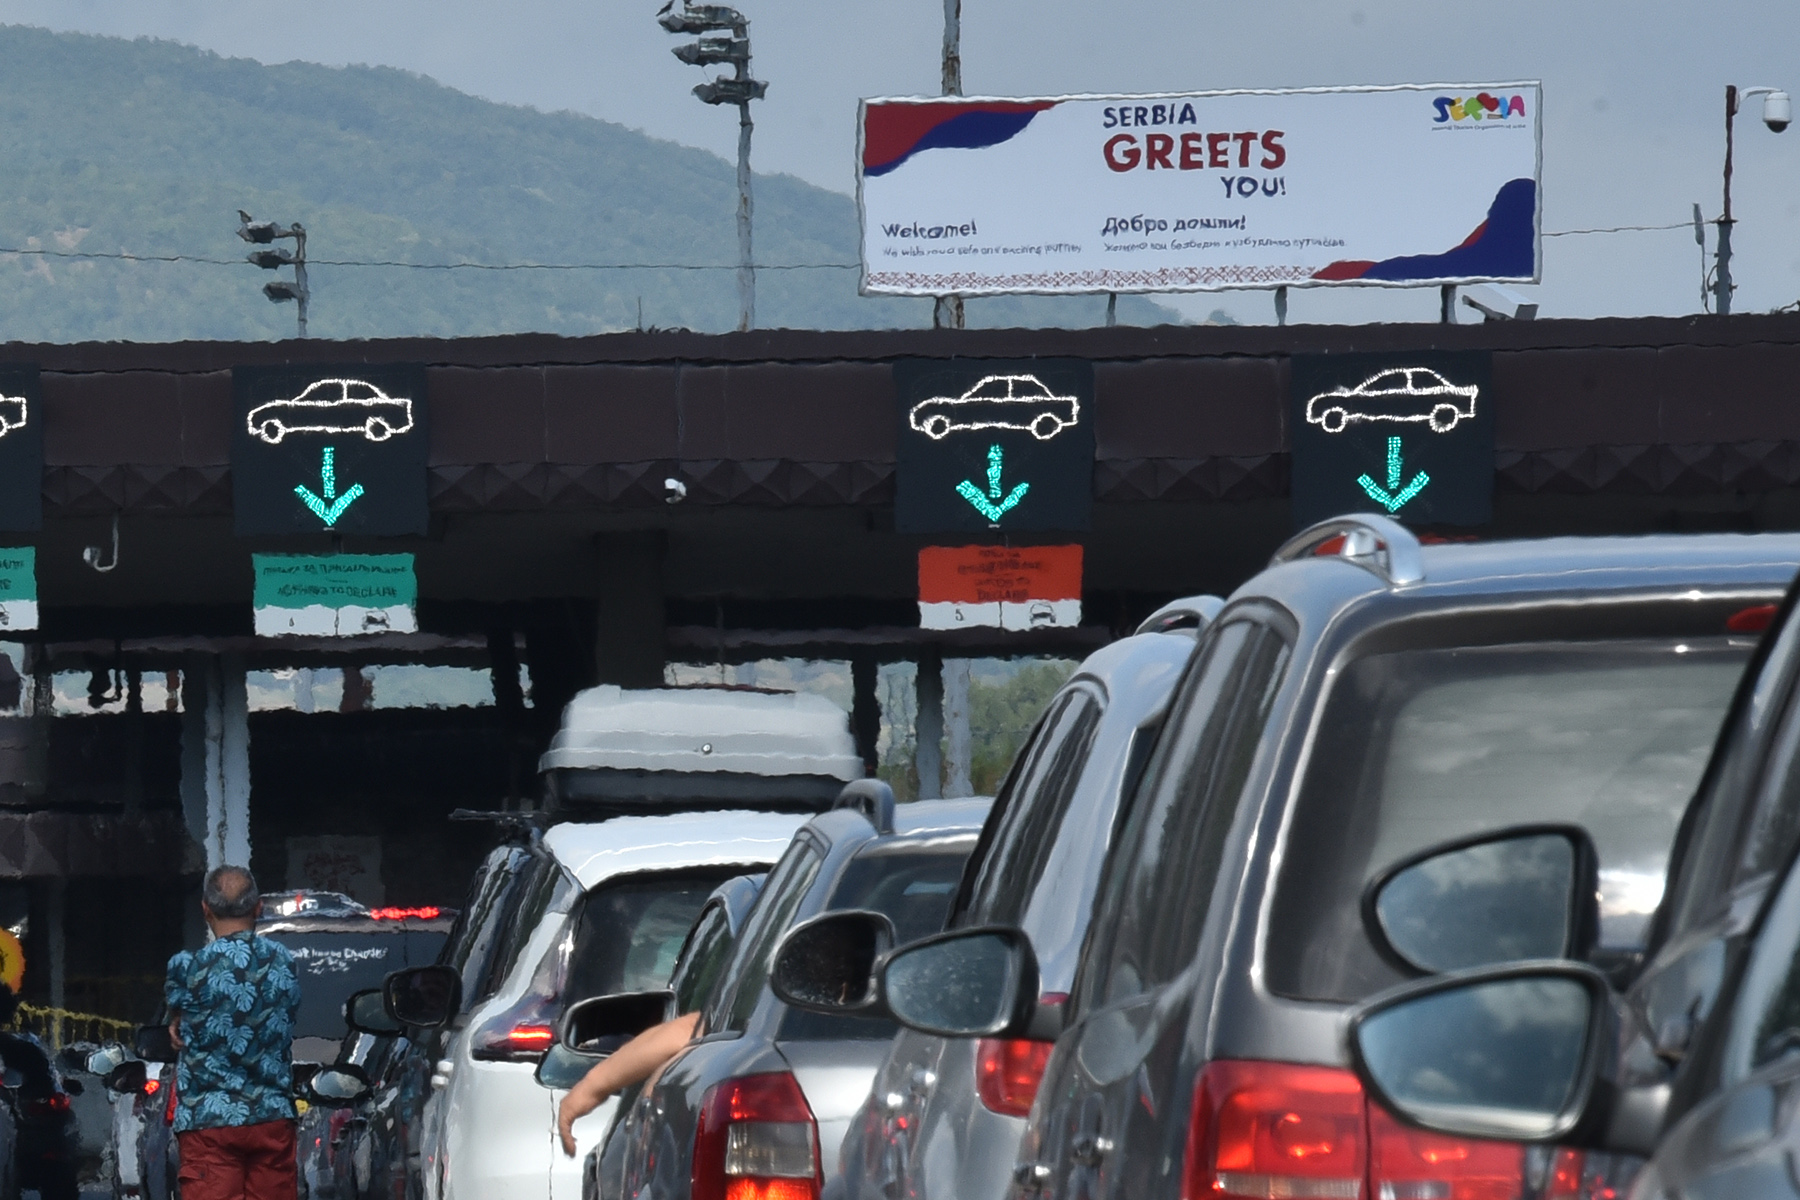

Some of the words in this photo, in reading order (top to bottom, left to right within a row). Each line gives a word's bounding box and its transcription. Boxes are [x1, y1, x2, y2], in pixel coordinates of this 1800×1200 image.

[1103, 103, 1197, 128] SERBIA
[1103, 130, 1286, 172] GREETS
[1220, 176, 1286, 198] YOU!
[881, 218, 978, 239] Welcome!
[1101, 214, 1168, 236] Добро
[1173, 215, 1246, 233] дошли!
[955, 609, 964, 621] 5
